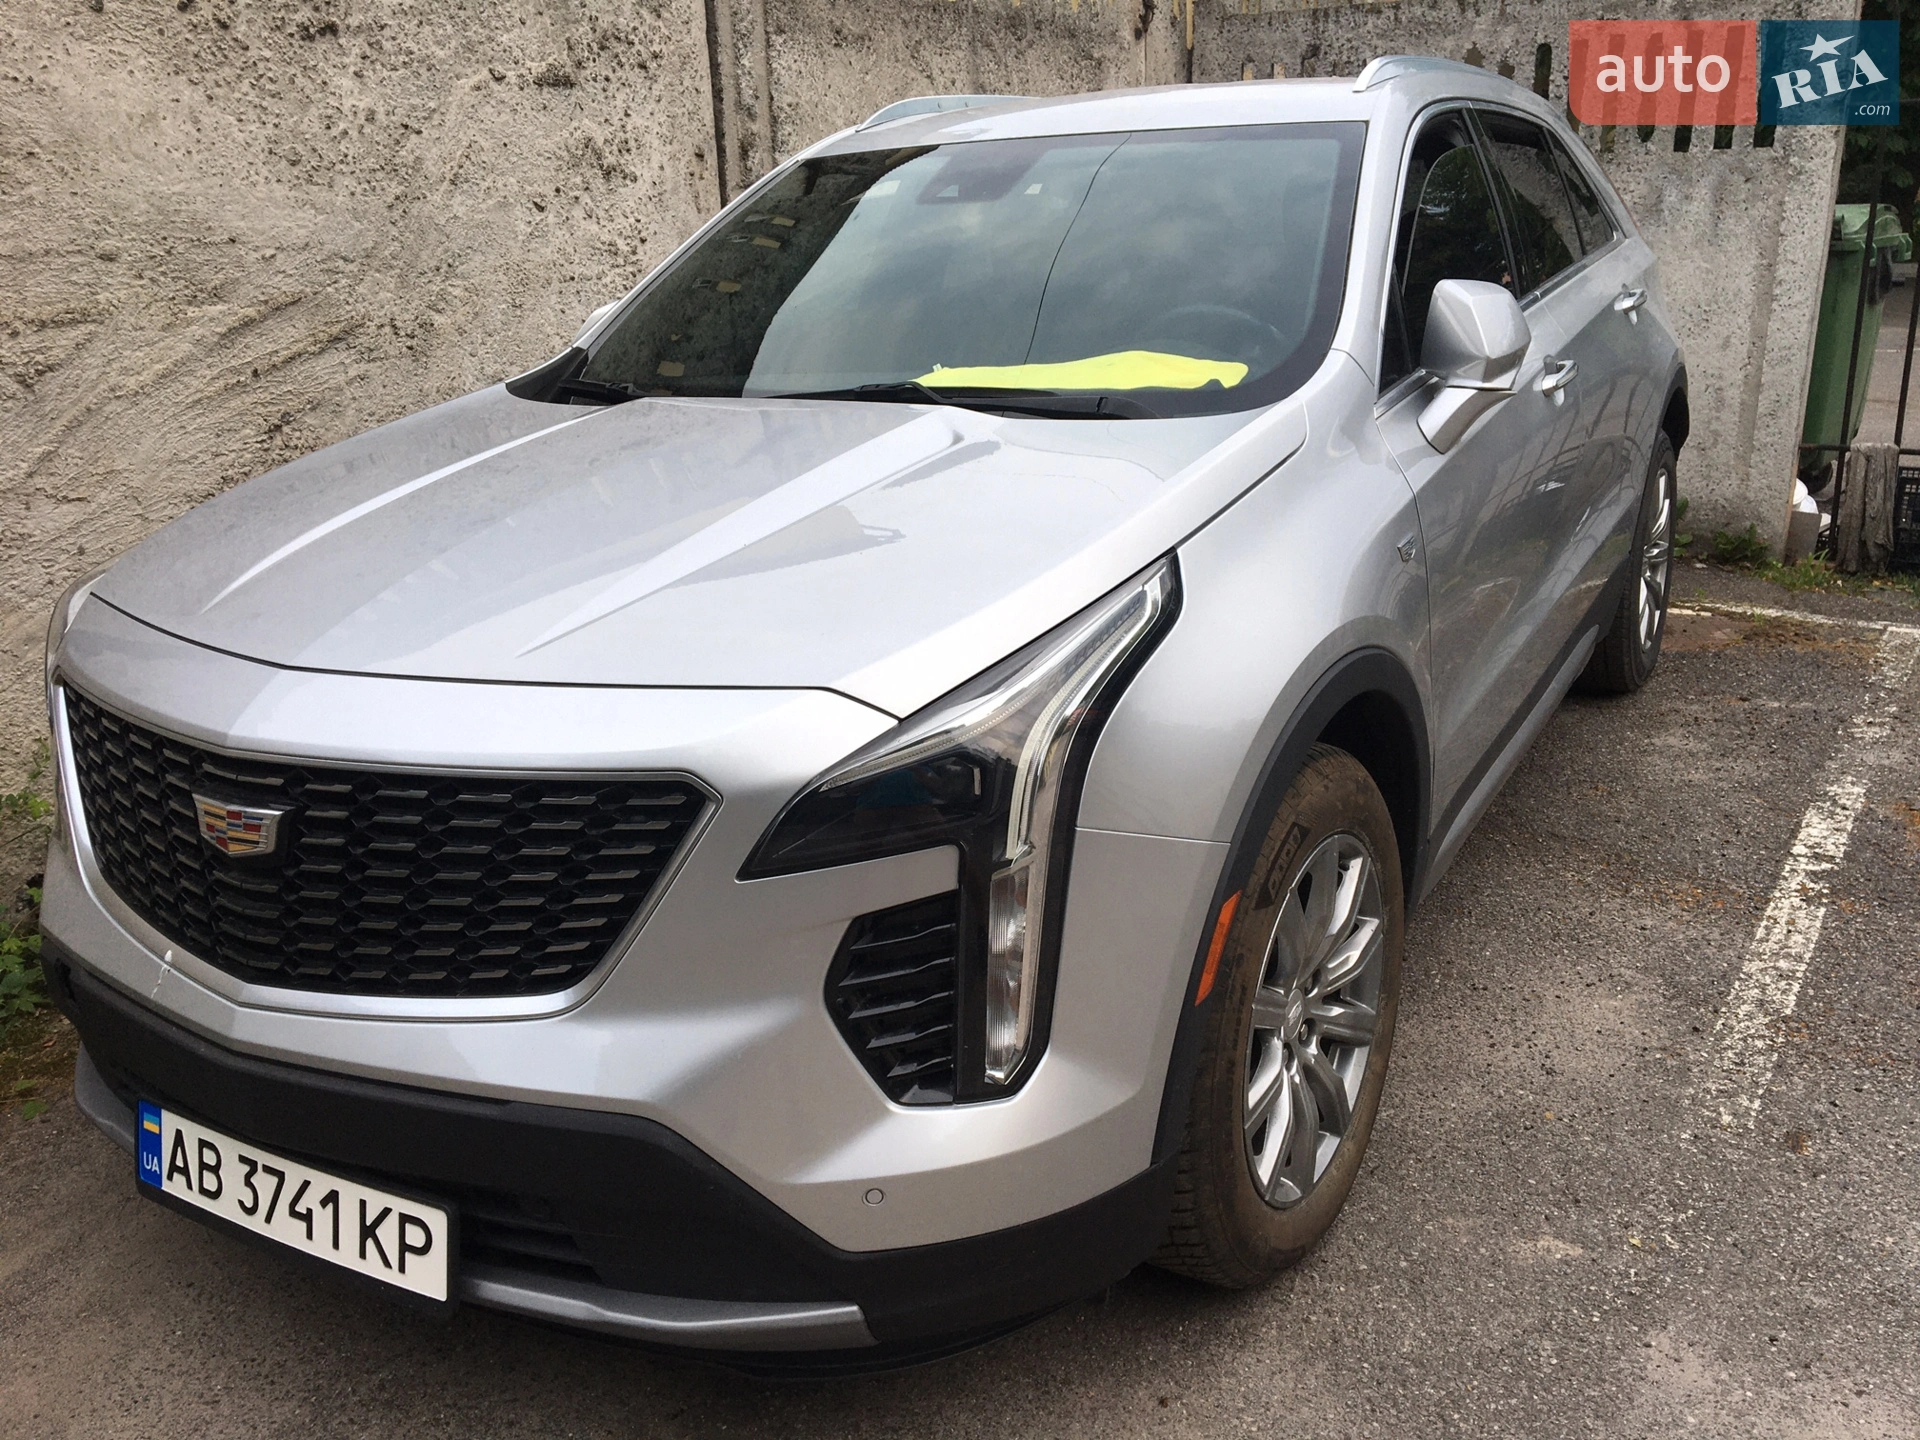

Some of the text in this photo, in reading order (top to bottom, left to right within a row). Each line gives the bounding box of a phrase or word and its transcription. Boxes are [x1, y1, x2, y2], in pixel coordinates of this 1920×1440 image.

[143, 1151, 160, 1175] UA
[166, 1128, 433, 1275] AB 3741 KP
